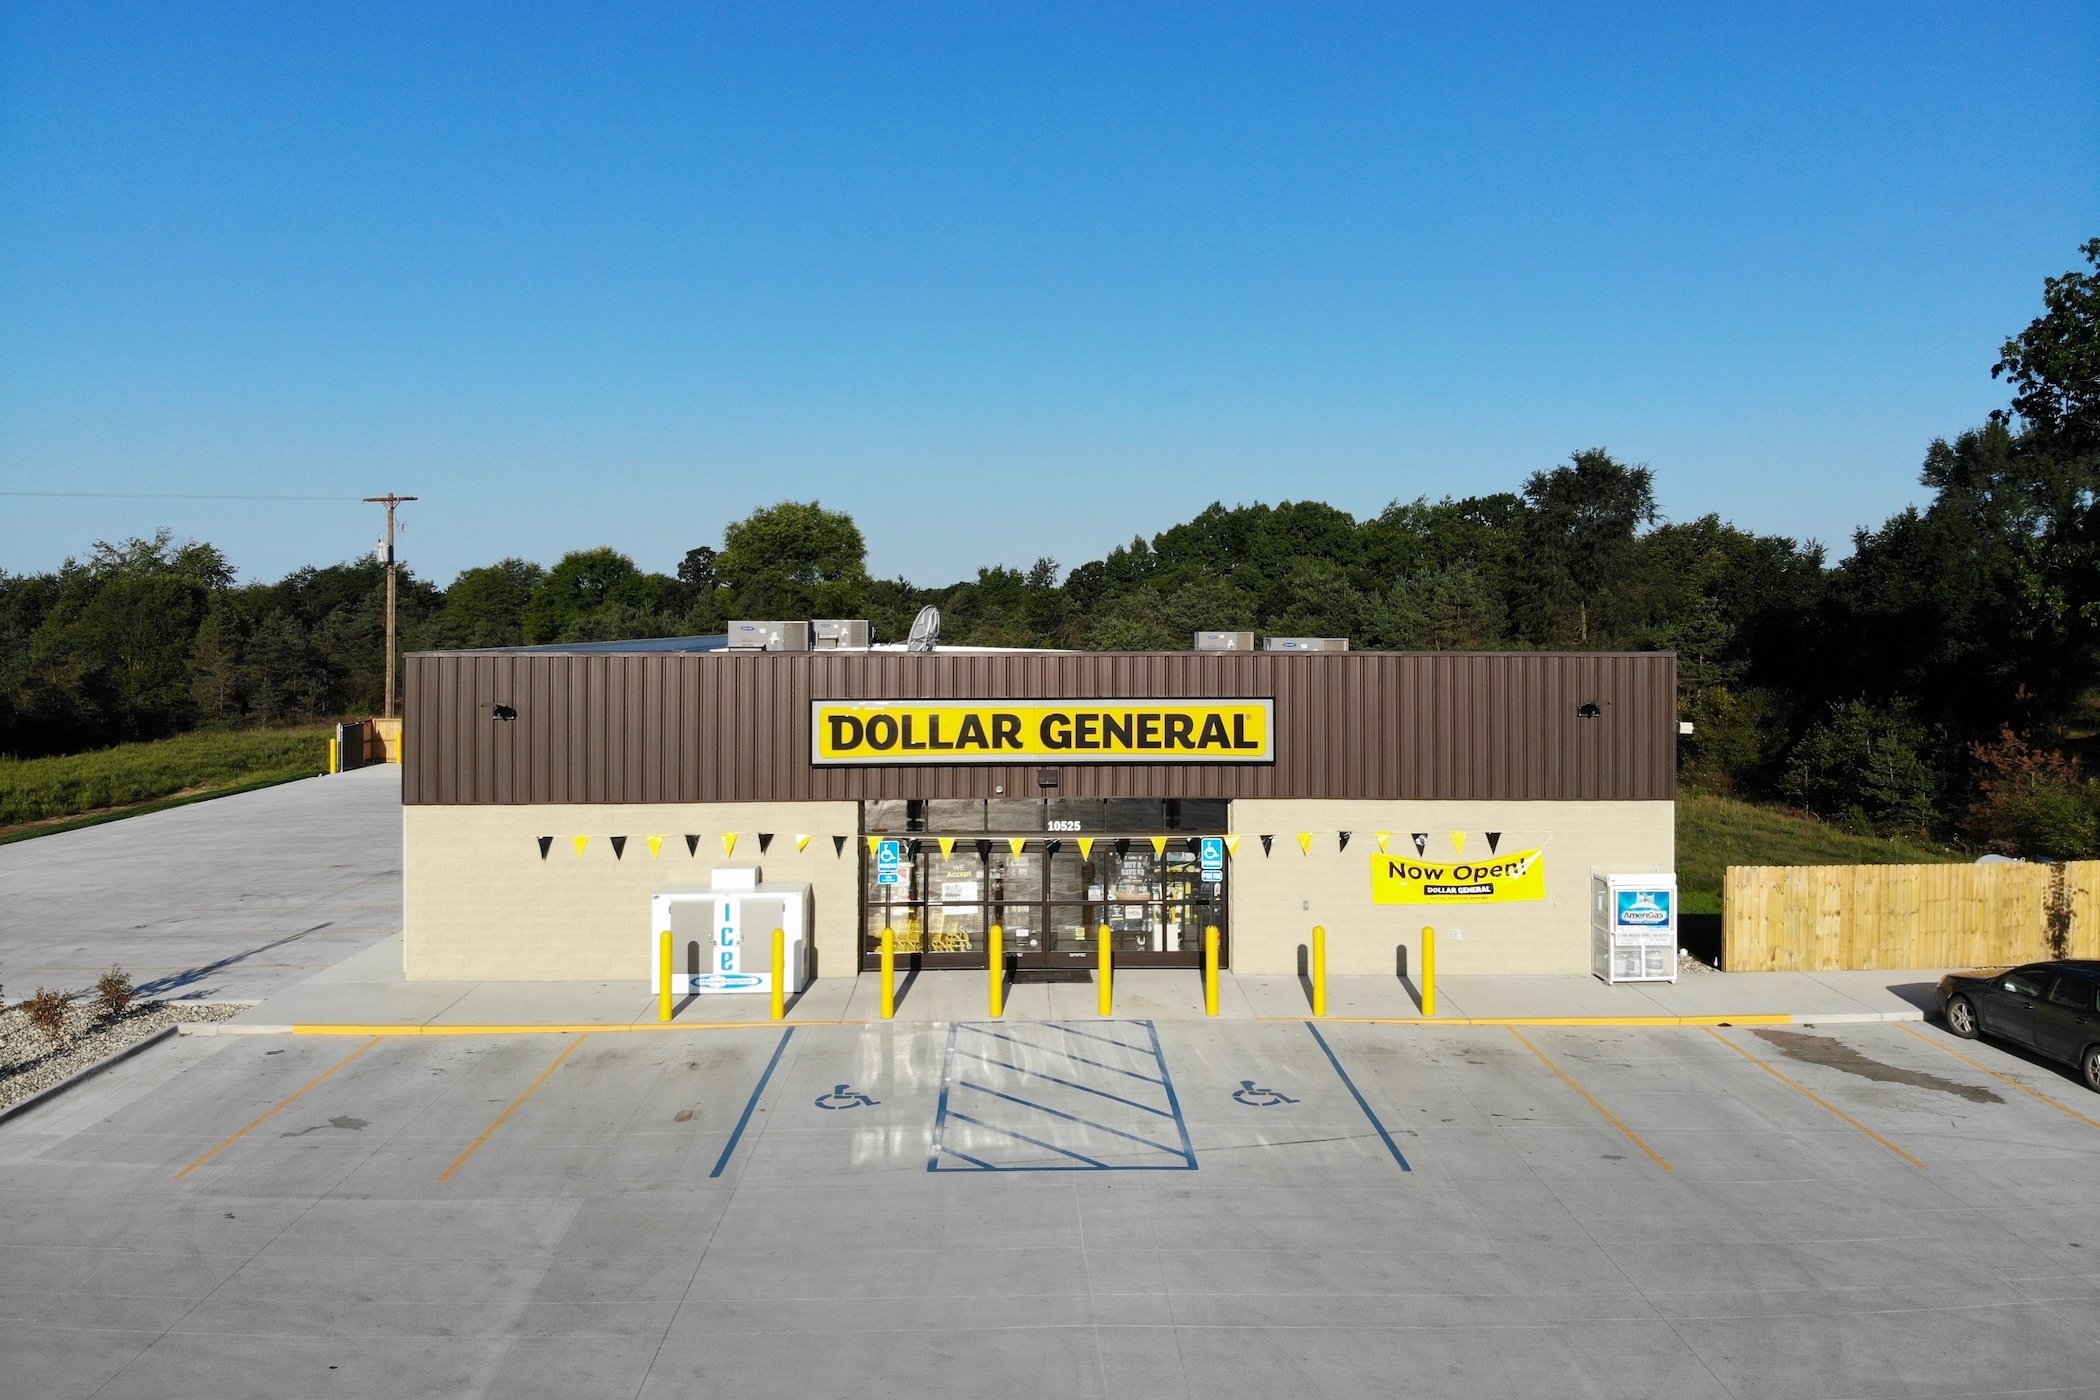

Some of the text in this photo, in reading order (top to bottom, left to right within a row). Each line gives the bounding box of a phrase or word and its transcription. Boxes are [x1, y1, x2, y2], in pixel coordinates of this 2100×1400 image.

[828, 713, 1259, 751] DOLLAR GENERAL
[1047, 820, 1081, 831] 10525
[946, 870, 972, 878] Accept
[1388, 858, 1526, 882] Now Open!
[1458, 885, 1492, 893] GENERAL
[1623, 911, 1664, 919] AmeriGas
